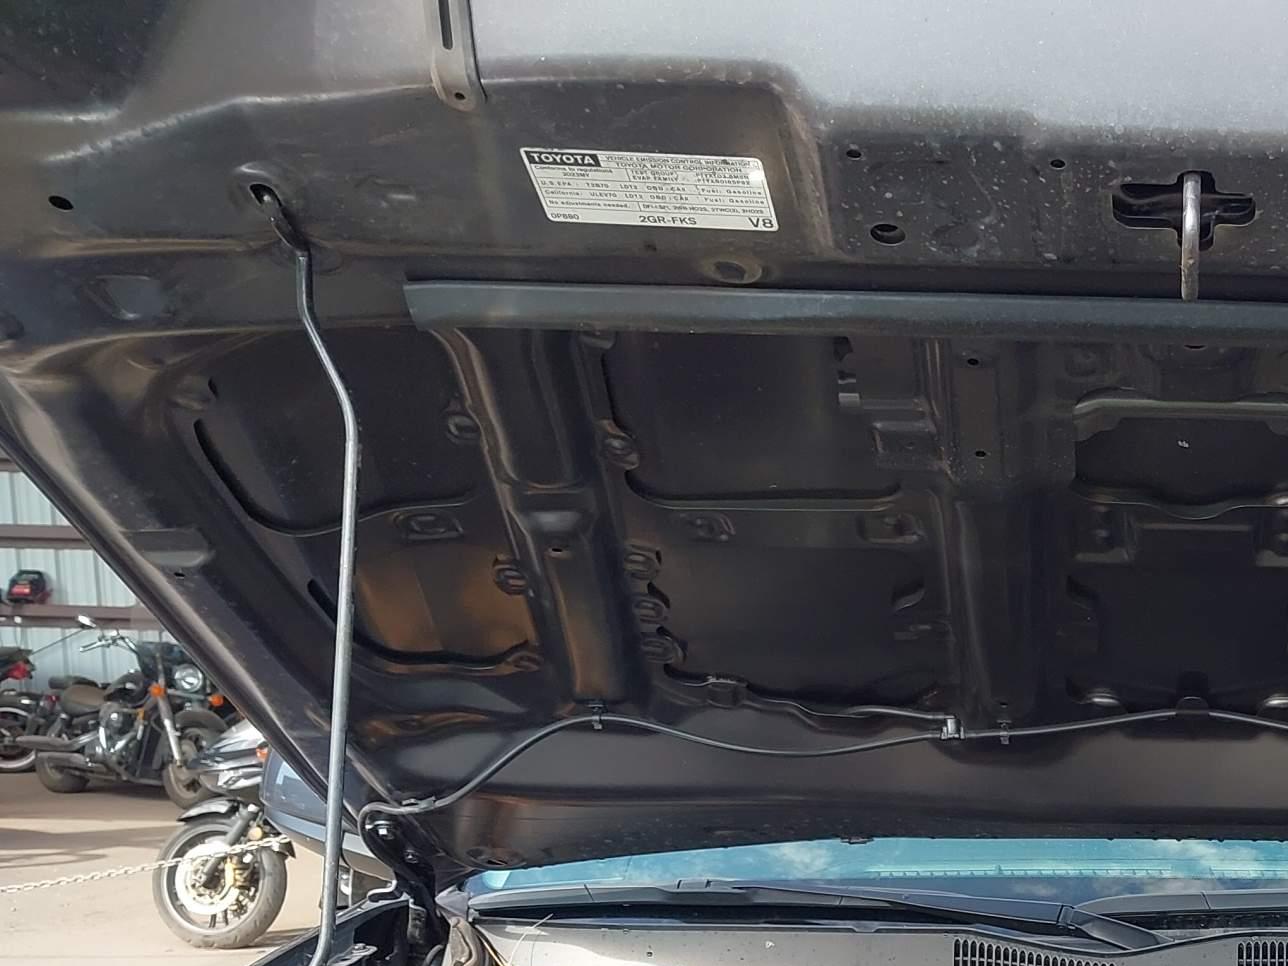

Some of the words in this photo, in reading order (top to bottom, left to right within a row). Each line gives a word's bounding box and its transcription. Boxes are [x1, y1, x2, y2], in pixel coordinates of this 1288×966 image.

[530, 153, 596, 165] TOYOTA
[682, 165, 743, 173] CORPORATION
[639, 215, 697, 225] 2GR-FKS
